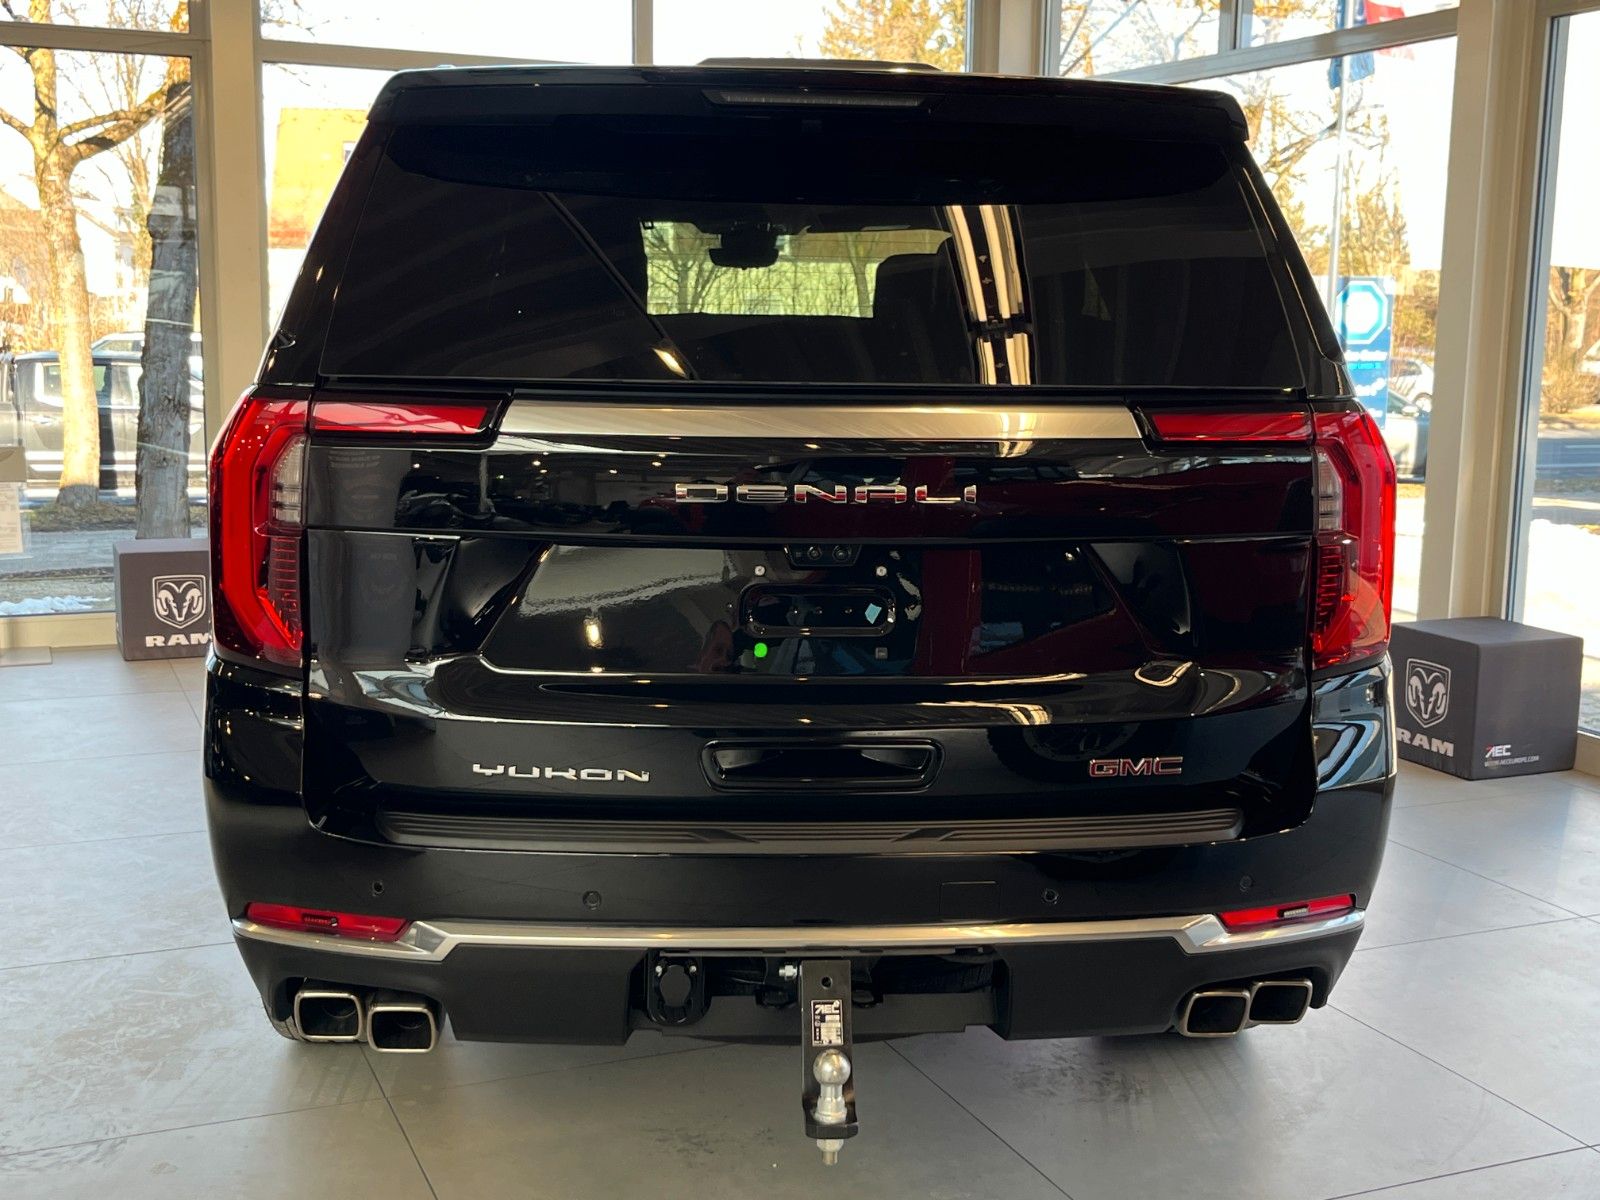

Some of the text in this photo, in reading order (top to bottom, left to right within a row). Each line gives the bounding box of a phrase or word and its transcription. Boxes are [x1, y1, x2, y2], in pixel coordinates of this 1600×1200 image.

[675, 483, 977, 503] DENALI
[145, 632, 209, 648] RAM
[1396, 727, 1454, 757] RAM
[1485, 744, 1512, 758] AEC
[472, 763, 650, 782] YUKON
[1089, 756, 1184, 778] GMC
